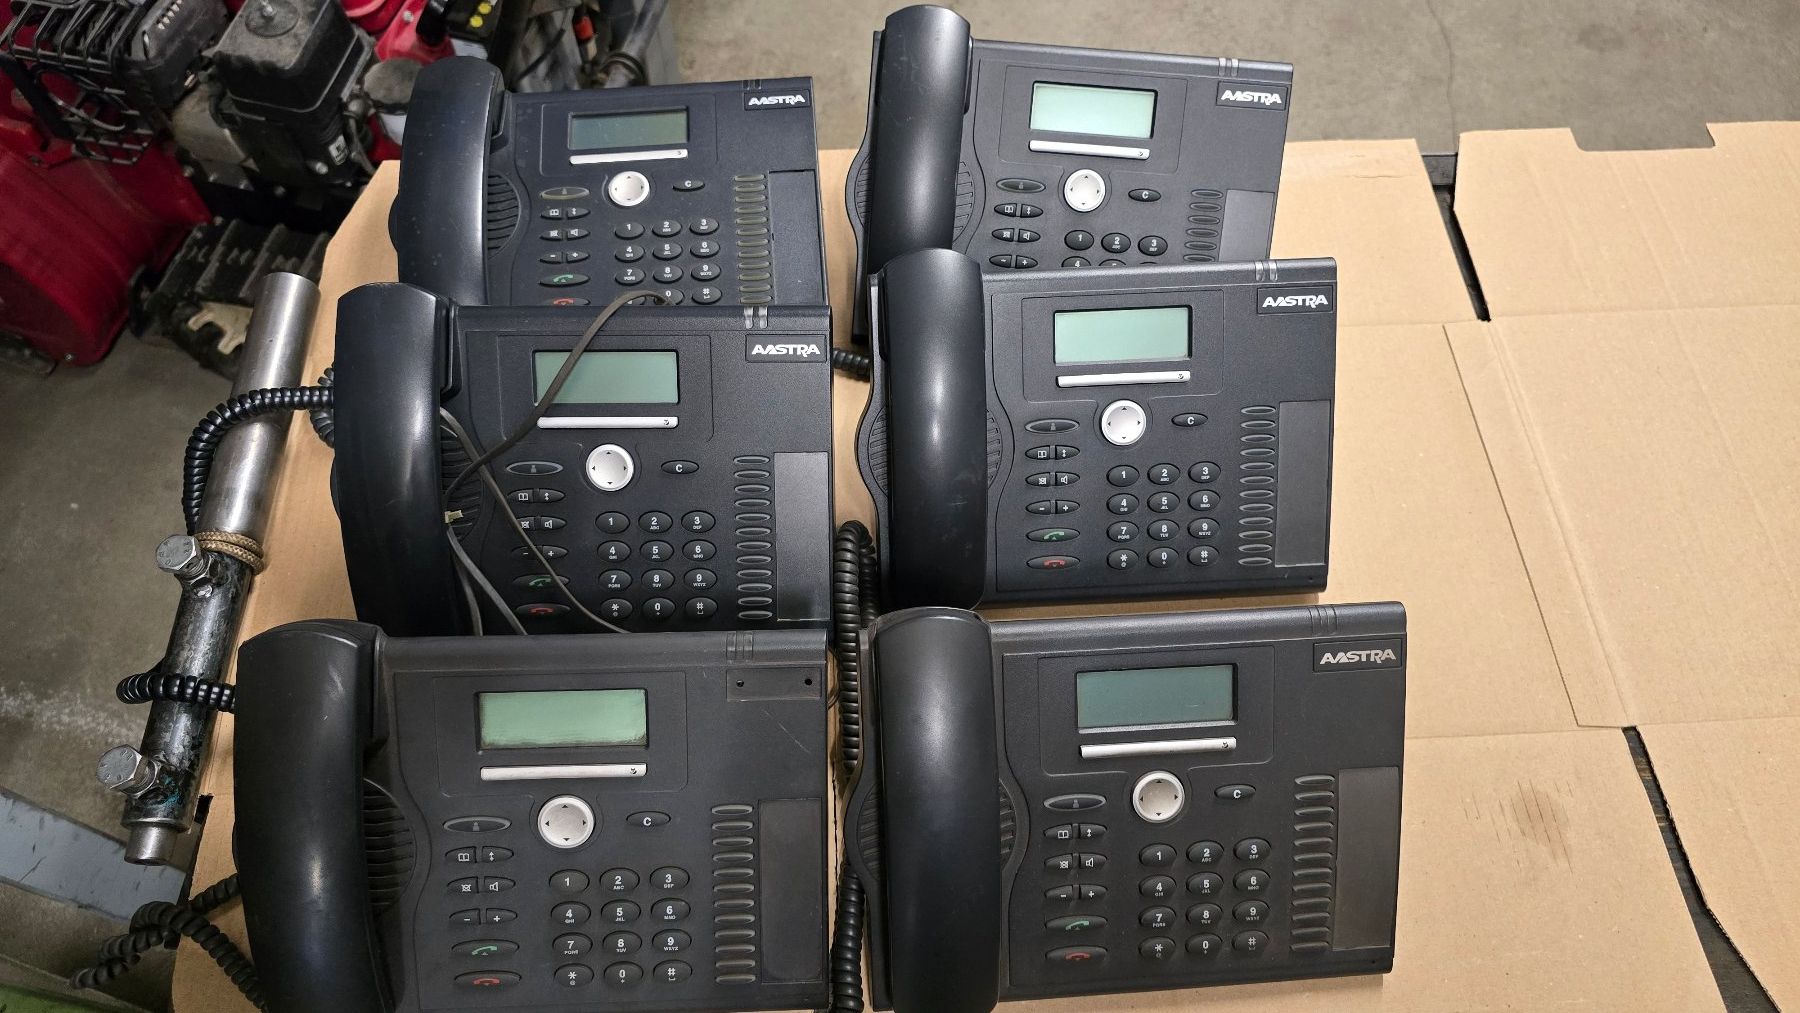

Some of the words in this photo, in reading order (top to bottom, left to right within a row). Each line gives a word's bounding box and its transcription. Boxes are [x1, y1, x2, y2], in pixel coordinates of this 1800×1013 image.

[748, 94, 806, 106] AASTRA
[1220, 90, 1282, 106] AASTRA
[684, 179, 692, 188] C
[1141, 190, 1149, 199] C
[1114, 236, 1120, 245] 2
[1151, 239, 1157, 247] 3
[1262, 294, 1329, 309] AASTRA
[751, 344, 821, 358] AASTRA
[1187, 416, 1195, 425] C
[675, 463, 683, 473] C
[1161, 468, 1168, 477] 2
[1202, 466, 1209, 475] 3
[1120, 498, 1127, 507] 4
[1161, 496, 1168, 505] 5
[1202, 494, 1209, 503] 6
[651, 516, 658, 525] 2
[694, 516, 701, 525] 3
[1120, 526, 1127, 535] 7
[1161, 524, 1168, 533] 8
[1201, 522, 1209, 531] 9
[609, 546, 616, 555] 4
[652, 545, 659, 554] 5
[695, 544, 702, 554] 6
[1161, 551, 1168, 561] 0
[610, 574, 617, 584] 7
[653, 574, 660, 583] 8
[696, 573, 703, 582] 9
[654, 602, 661, 611] 0
[1319, 648, 1397, 665] AASTRA
[1233, 789, 1242, 799] C
[642, 816, 652, 827] C
[1203, 847, 1210, 858] 2
[1250, 844, 1258, 854] 3
[614, 875, 622, 885] 2
[665, 873, 672, 883] 3
[1250, 876, 1257, 886] 6
[1156, 882, 1163, 892] 4
[1203, 879, 1210, 889] 5
[565, 908, 573, 918] 4
[616, 907, 624, 917] 5
[666, 905, 673, 915] 6
[1202, 910, 1210, 919] 8
[1249, 906, 1257, 916] 9
[1155, 913, 1163, 923] 7
[567, 940, 575, 950] 7
[617, 938, 625, 948] 8
[667, 936, 675, 946] 9
[1202, 940, 1209, 950] 0
[618, 969, 626, 978] 0
